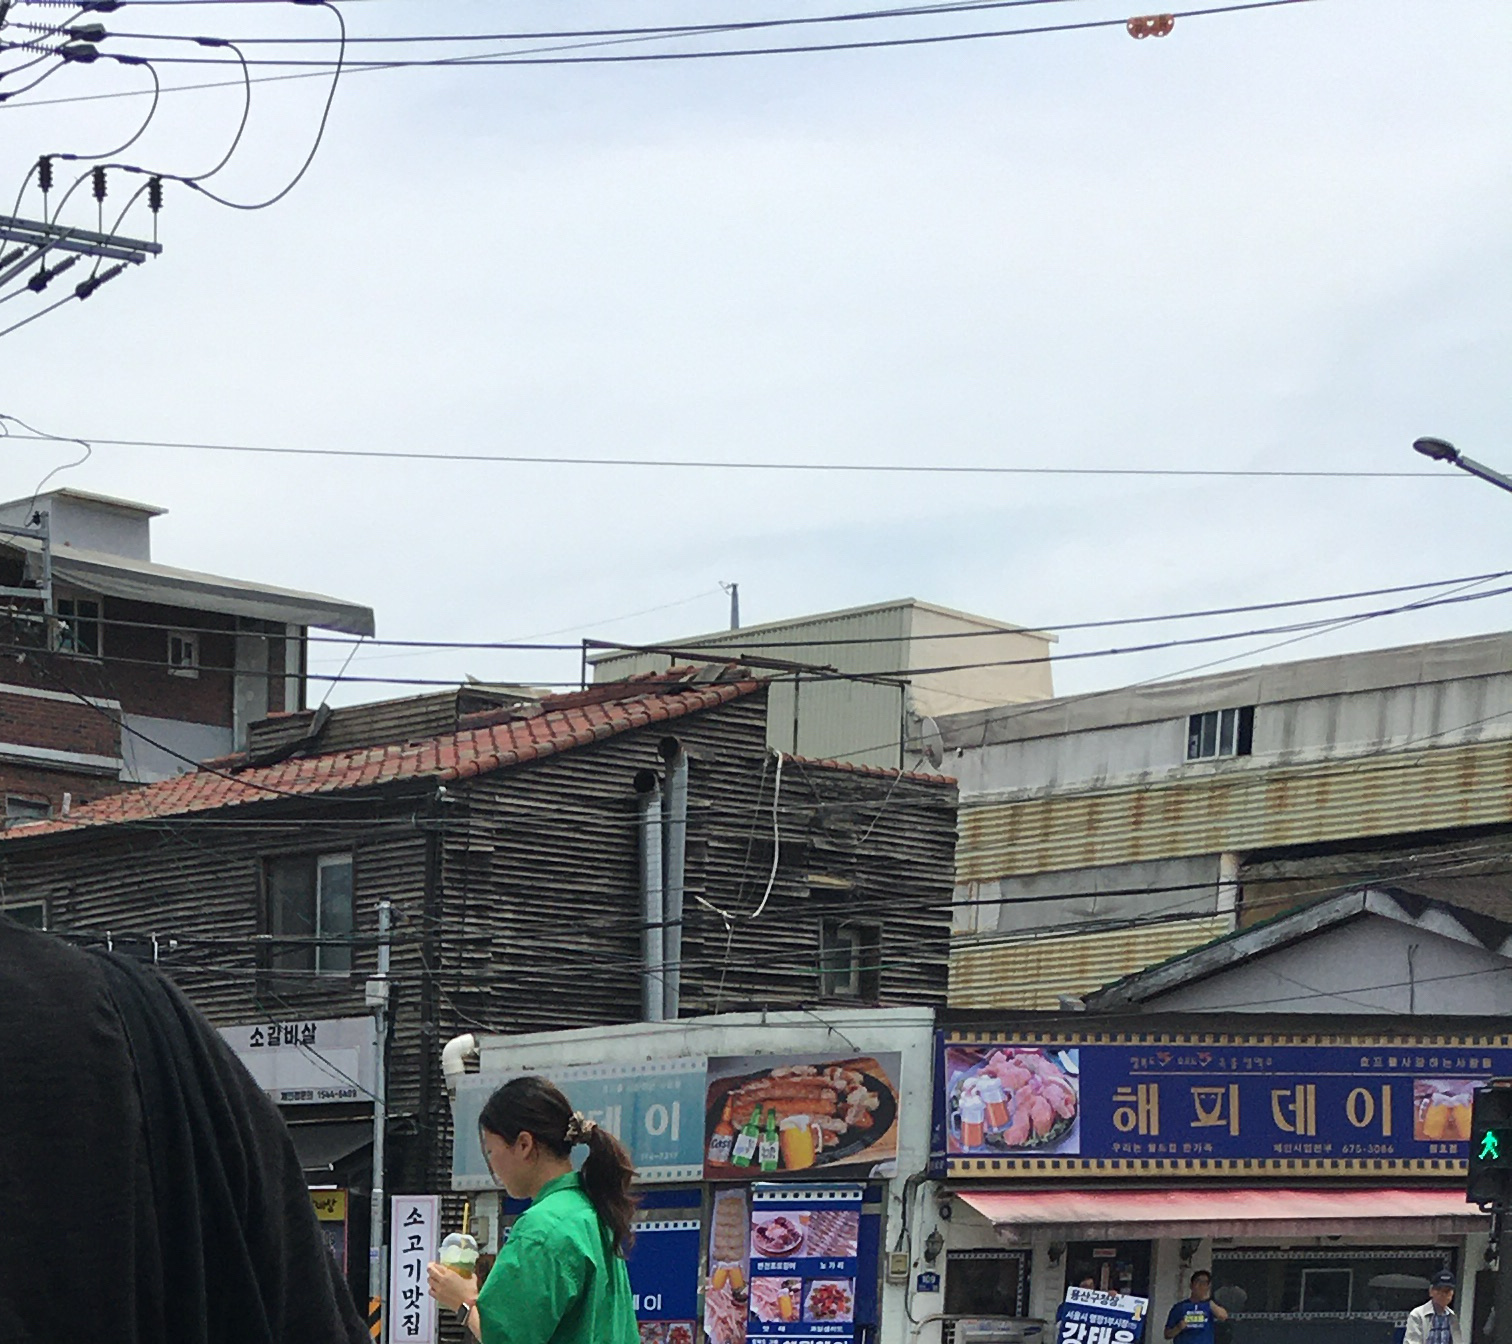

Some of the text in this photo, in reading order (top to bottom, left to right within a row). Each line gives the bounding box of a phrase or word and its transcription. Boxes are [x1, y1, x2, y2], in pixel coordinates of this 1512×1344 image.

[249, 1023, 317, 1048] 소갈비살
[1112, 1083, 1392, 1136] 해피데이
[401, 1207, 426, 1337] 소고기맛집
